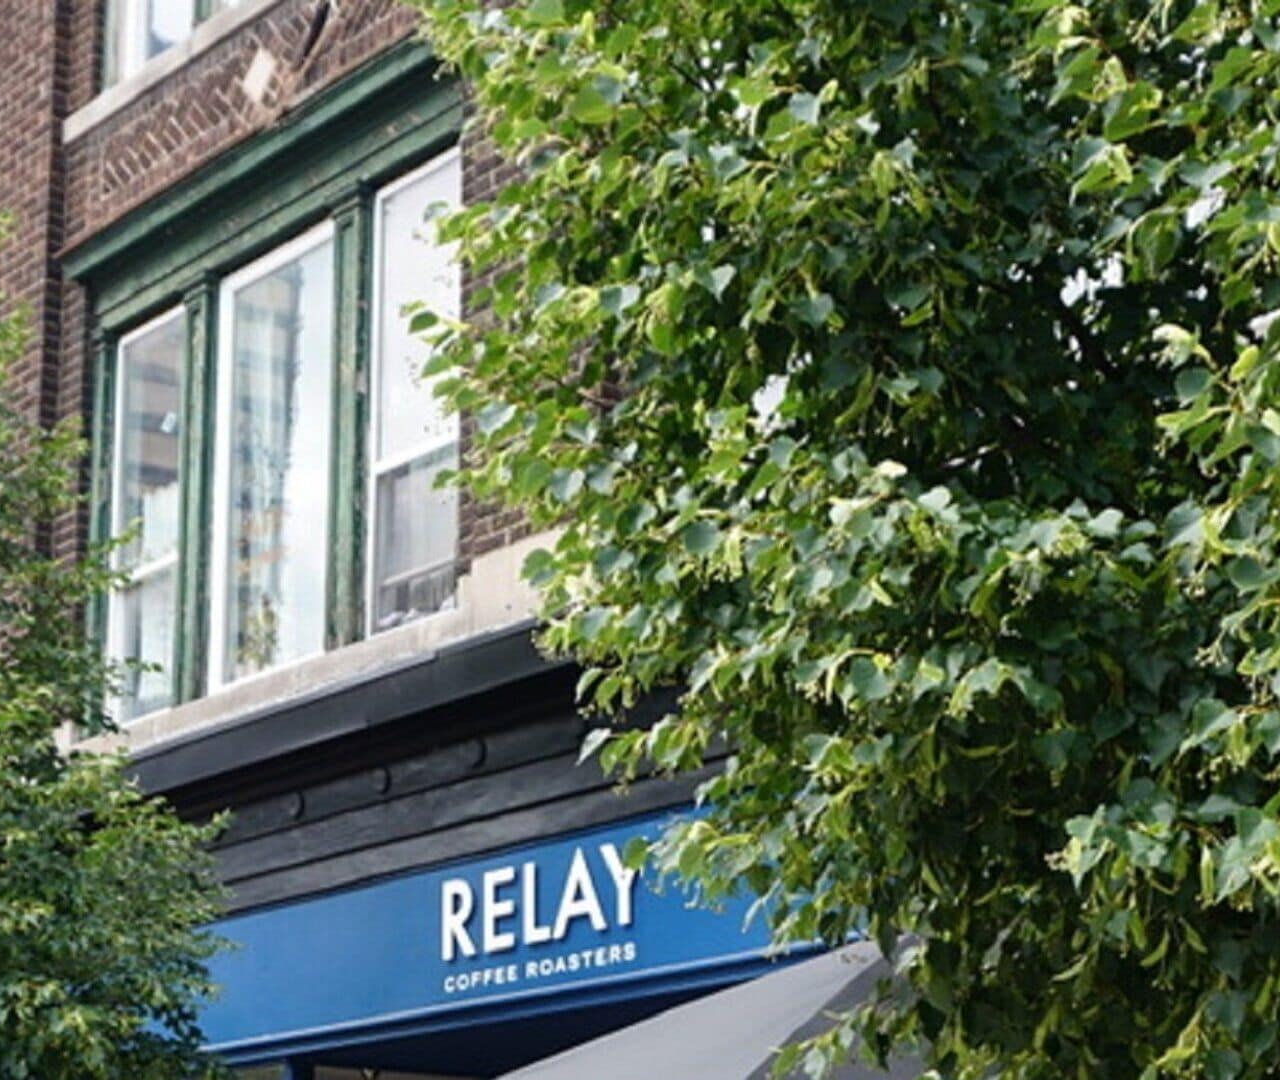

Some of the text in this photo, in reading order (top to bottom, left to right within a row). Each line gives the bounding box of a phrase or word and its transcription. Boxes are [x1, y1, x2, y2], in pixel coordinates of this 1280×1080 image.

[441, 843, 641, 962] RELAY
[443, 942, 636, 993] COFFEE ROASTERS
